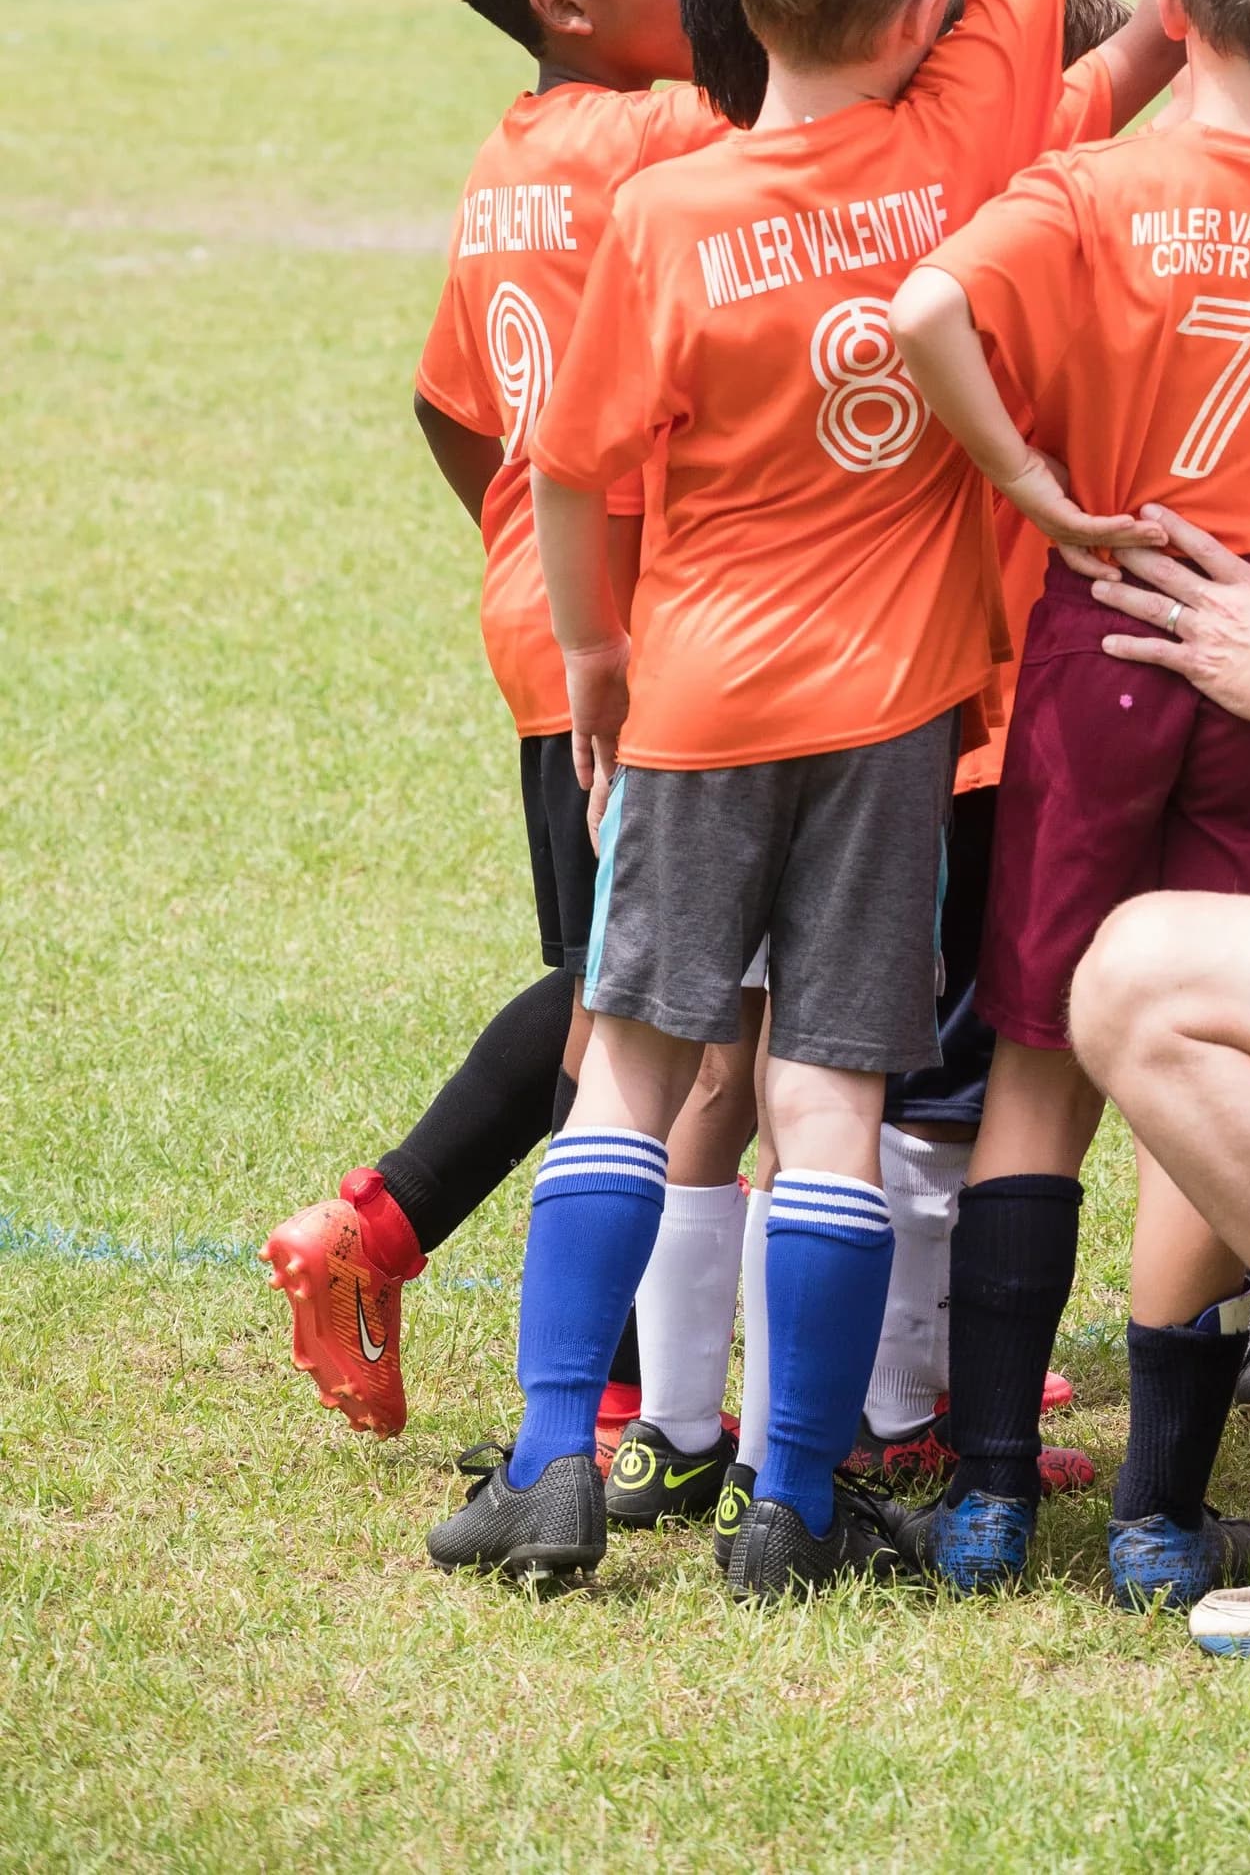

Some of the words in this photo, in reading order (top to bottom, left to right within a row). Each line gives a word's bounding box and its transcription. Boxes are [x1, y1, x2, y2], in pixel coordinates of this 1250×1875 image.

[496, 184, 577, 252] VALENTINE
[697, 216, 803, 308] MILLER
[795, 184, 947, 277] VALENTINE
[1132, 207, 1221, 246] MILLER
[487, 282, 553, 465] 9
[811, 297, 931, 473] 8
